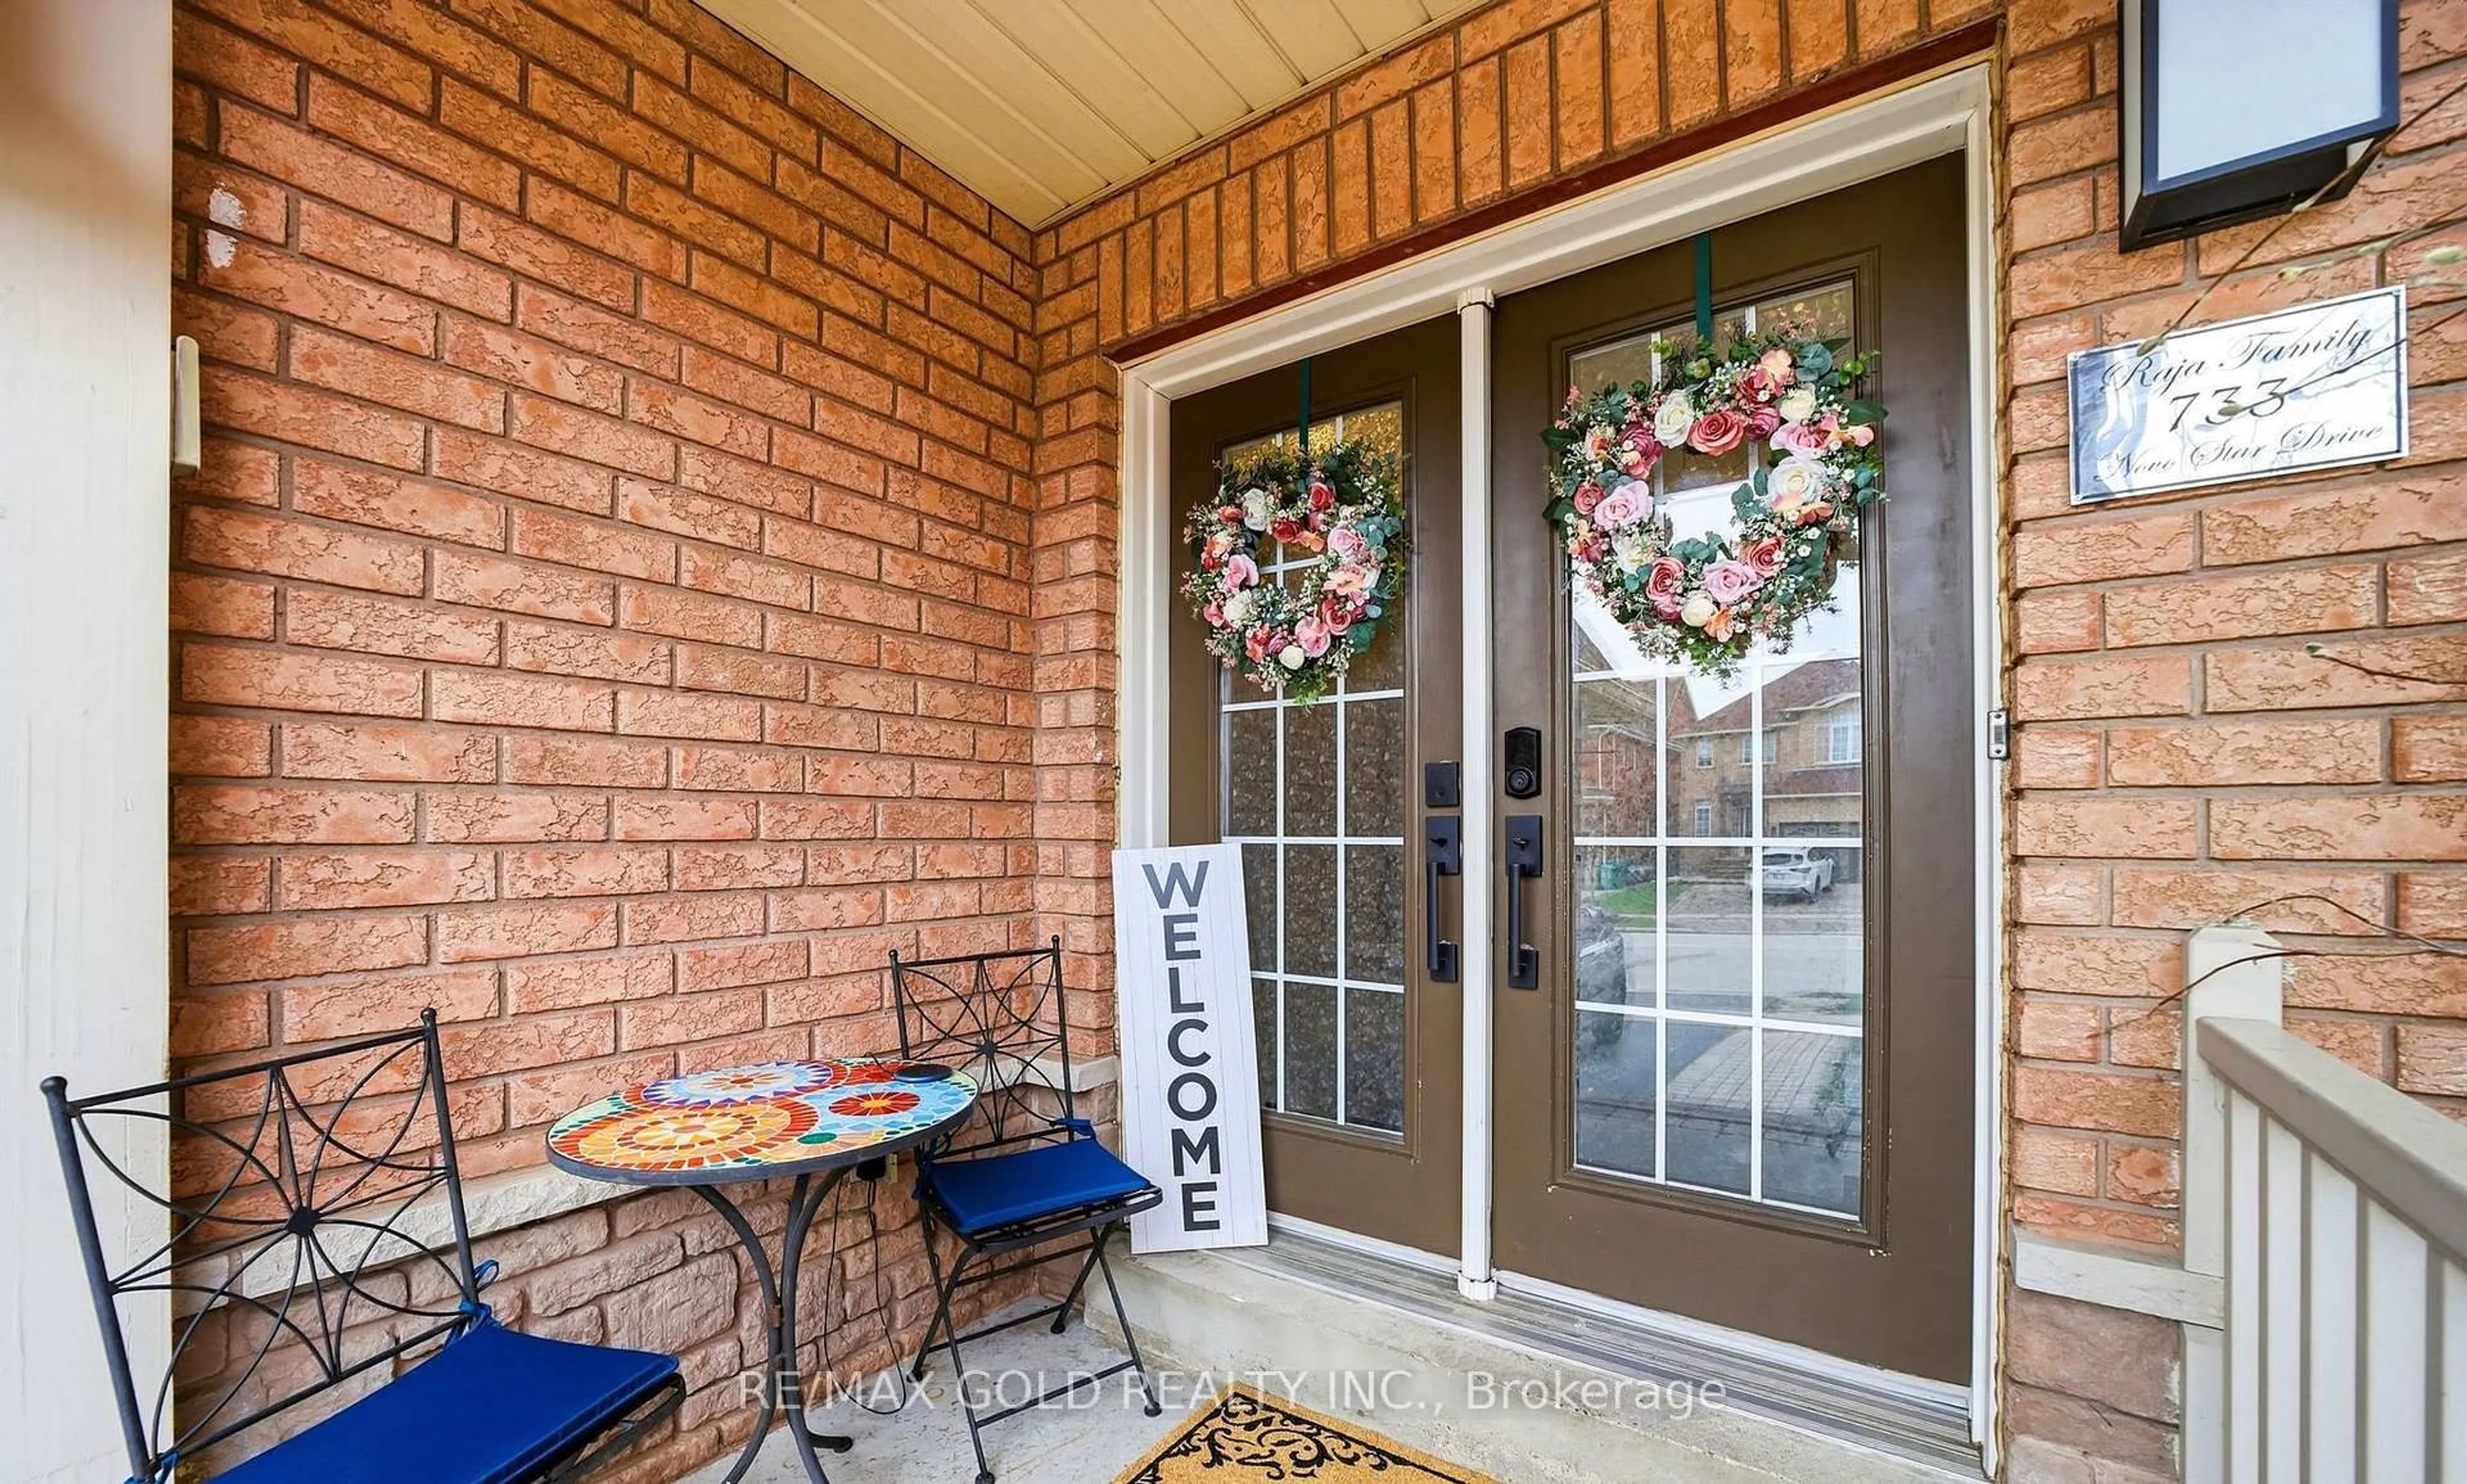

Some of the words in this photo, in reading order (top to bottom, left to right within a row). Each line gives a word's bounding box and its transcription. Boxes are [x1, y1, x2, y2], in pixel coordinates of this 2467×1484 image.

[2101, 356, 2204, 396] Raja
[2219, 319, 2372, 366] Family
[2168, 377, 2287, 434] 733
[2190, 434, 2267, 470] Star
[2276, 419, 2383, 455] Drive
[1142, 860, 1221, 1232] WELCOME
